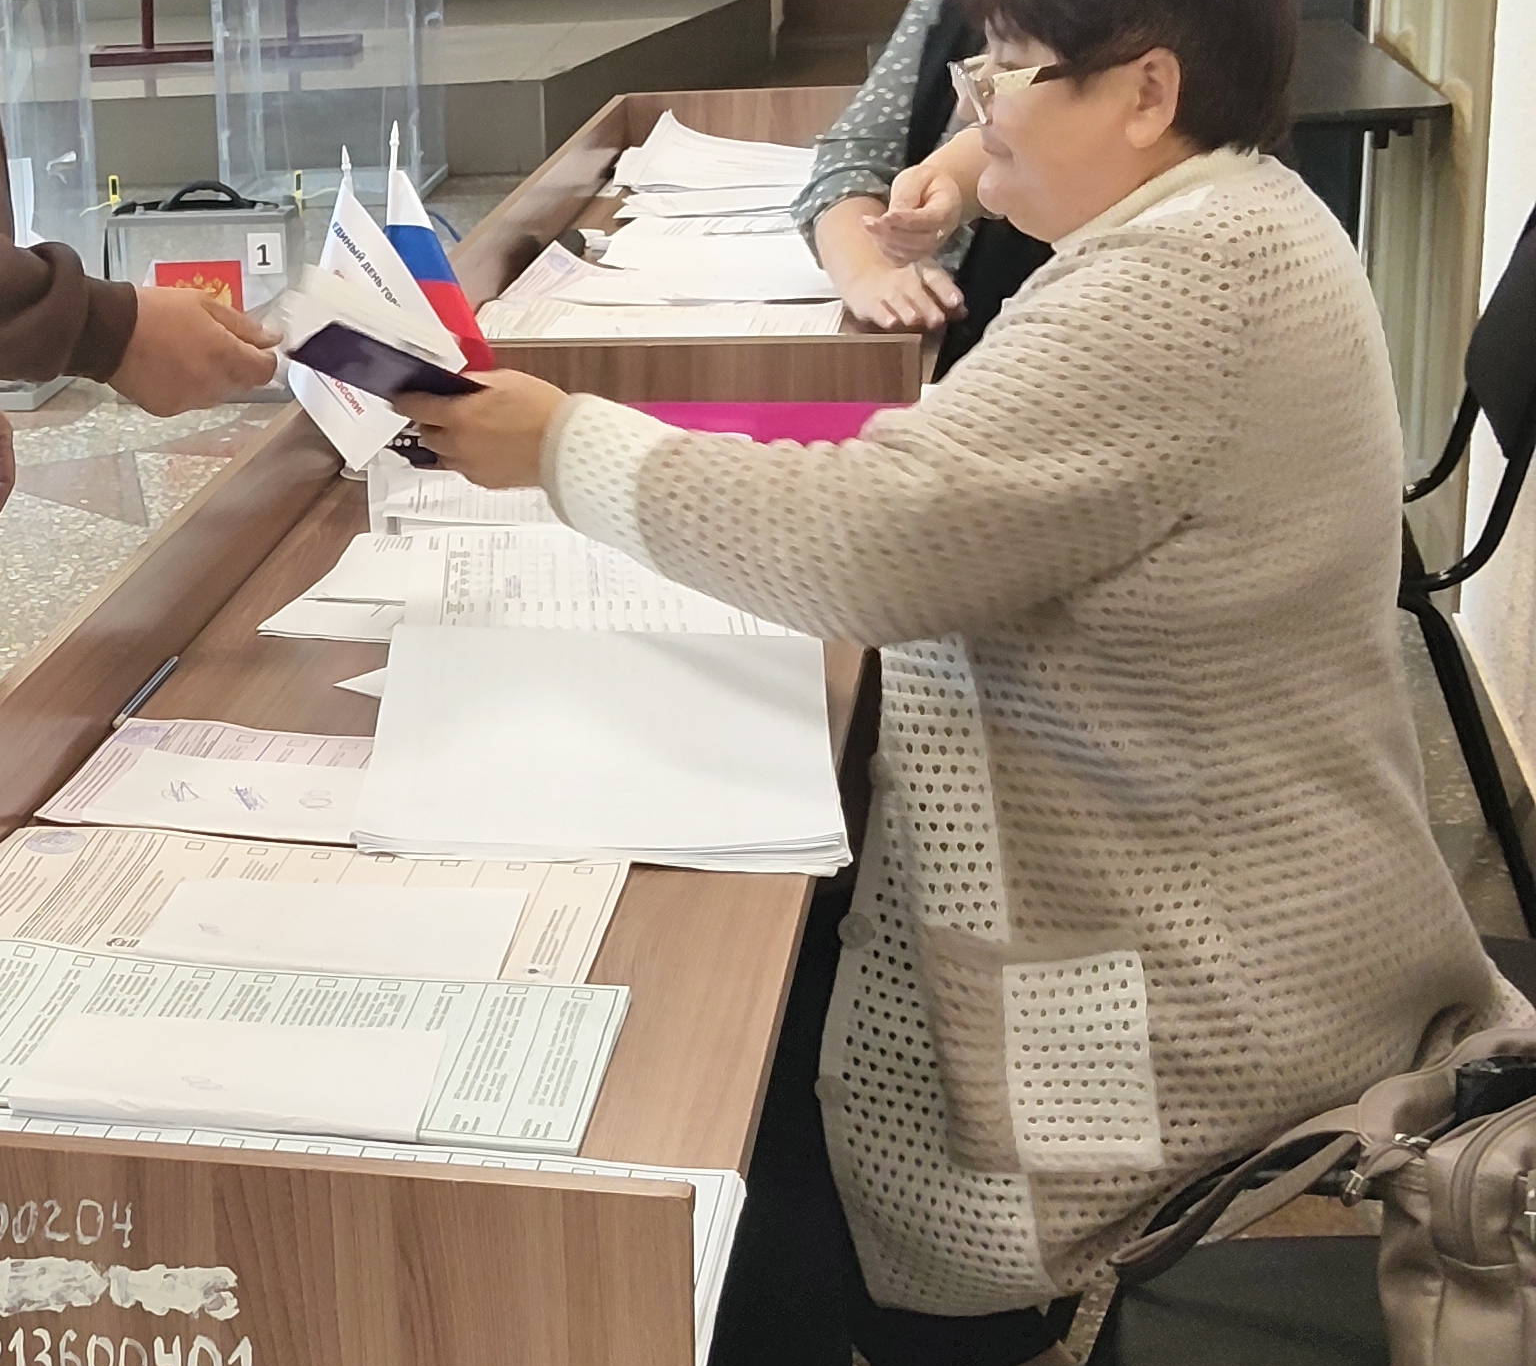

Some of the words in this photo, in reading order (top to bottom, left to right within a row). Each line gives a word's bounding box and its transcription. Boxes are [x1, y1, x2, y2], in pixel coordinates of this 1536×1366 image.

[256, 243, 271, 266] 1
[332, 221, 366, 262] ЕДИНЫЙ
[360, 261, 383, 288] ДЕНЬ
